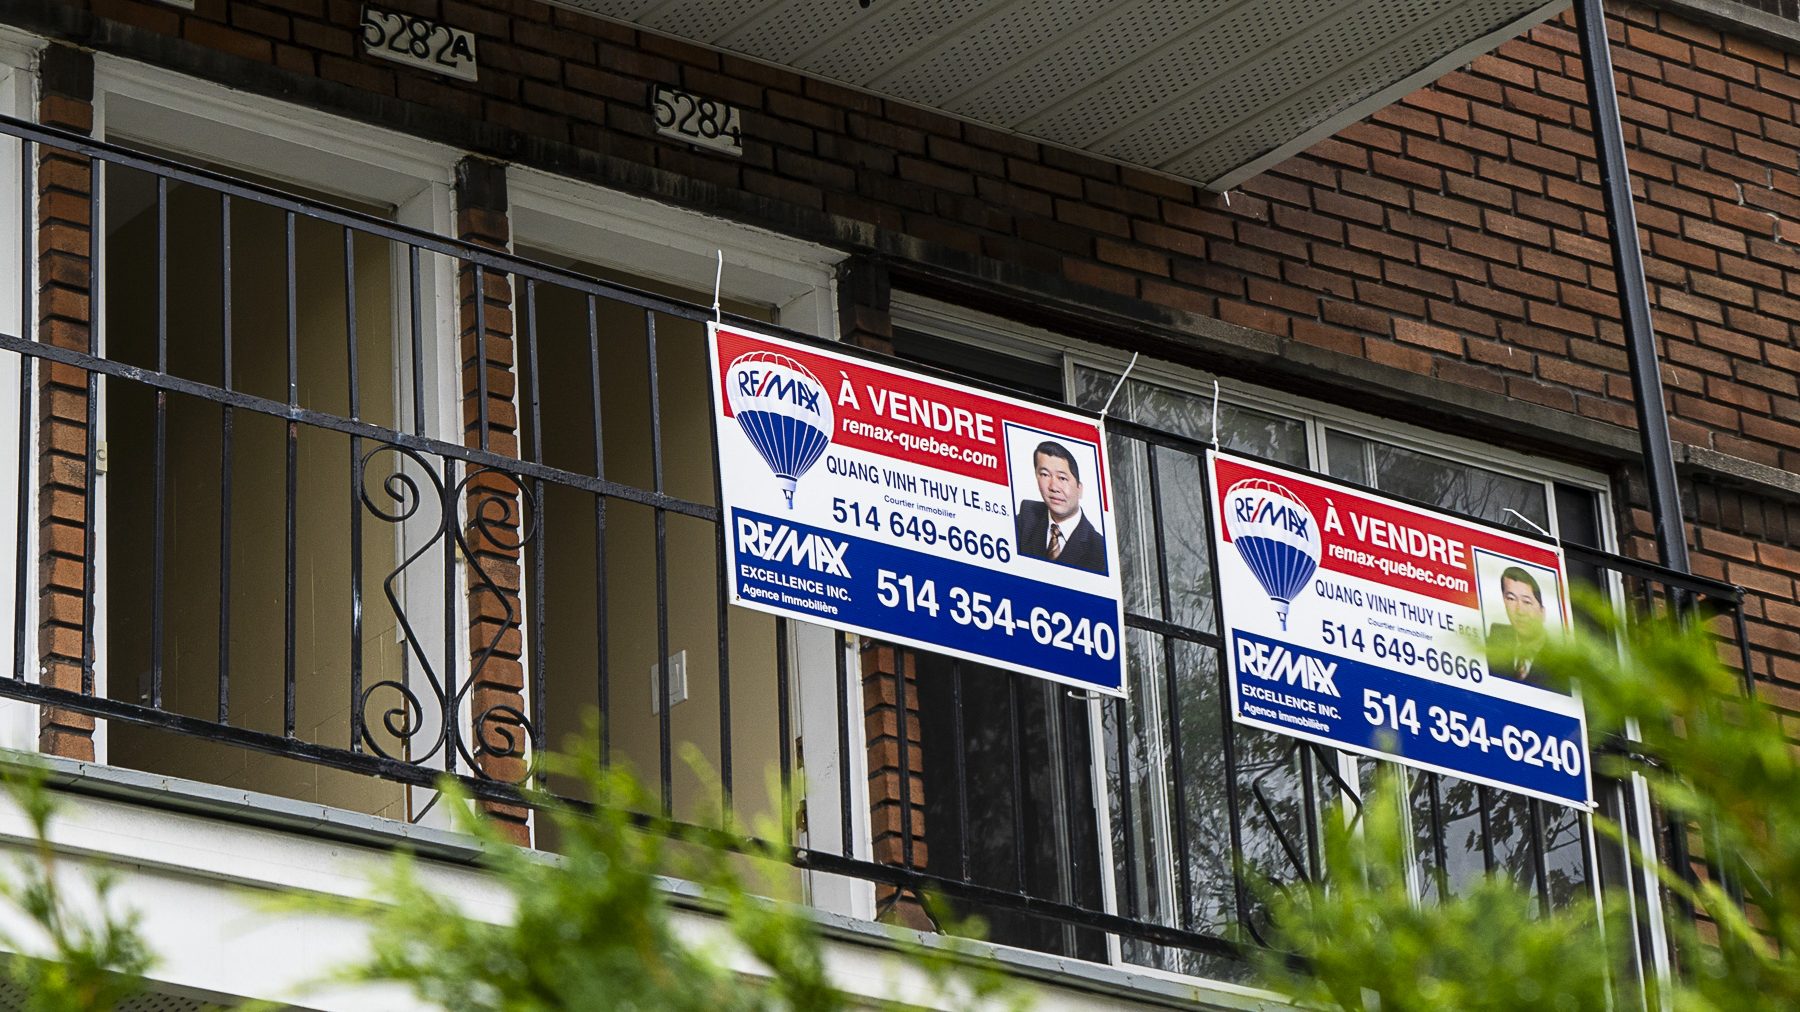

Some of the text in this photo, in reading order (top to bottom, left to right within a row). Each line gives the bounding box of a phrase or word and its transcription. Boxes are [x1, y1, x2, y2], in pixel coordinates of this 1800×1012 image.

[361, 9, 473, 69] 5282A
[654, 84, 742, 147] 5284
[738, 370, 820, 416] RE/MAX
[837, 370, 996, 444] À VENDRE
[842, 418, 998, 469] remax-quebec.com
[826, 455, 879, 484] QUANG
[883, 469, 917, 494] VINH
[920, 478, 958, 504] THUY
[985, 501, 1010, 517] B.C.S.
[884, 494, 956, 519] Courtier immobilier
[833, 497, 1011, 563] 514 649-6666
[1235, 497, 1309, 542] RE/MAX
[1324, 497, 1467, 570] À VENDRE
[737, 516, 852, 579] RE/MAX
[1328, 543, 1469, 593] remax-quebec.com
[741, 564, 852, 602] EXCELLENCE INC.
[743, 583, 838, 615] Agence immobilière
[1315, 579, 1362, 607] QUANG
[1366, 592, 1397, 617] VINH
[1399, 601, 1434, 626] THUY
[877, 568, 1116, 661] 514 354-6240
[1368, 617, 1433, 641] Courtier immobilier
[1237, 637, 1341, 698] RE/MAX
[1322, 619, 1483, 683] 514 649-6666
[1241, 683, 1342, 720] EXCELLENCE INC.
[1244, 701, 1330, 733] Agence immobilière
[1363, 688, 1582, 777] 514 354-6240
